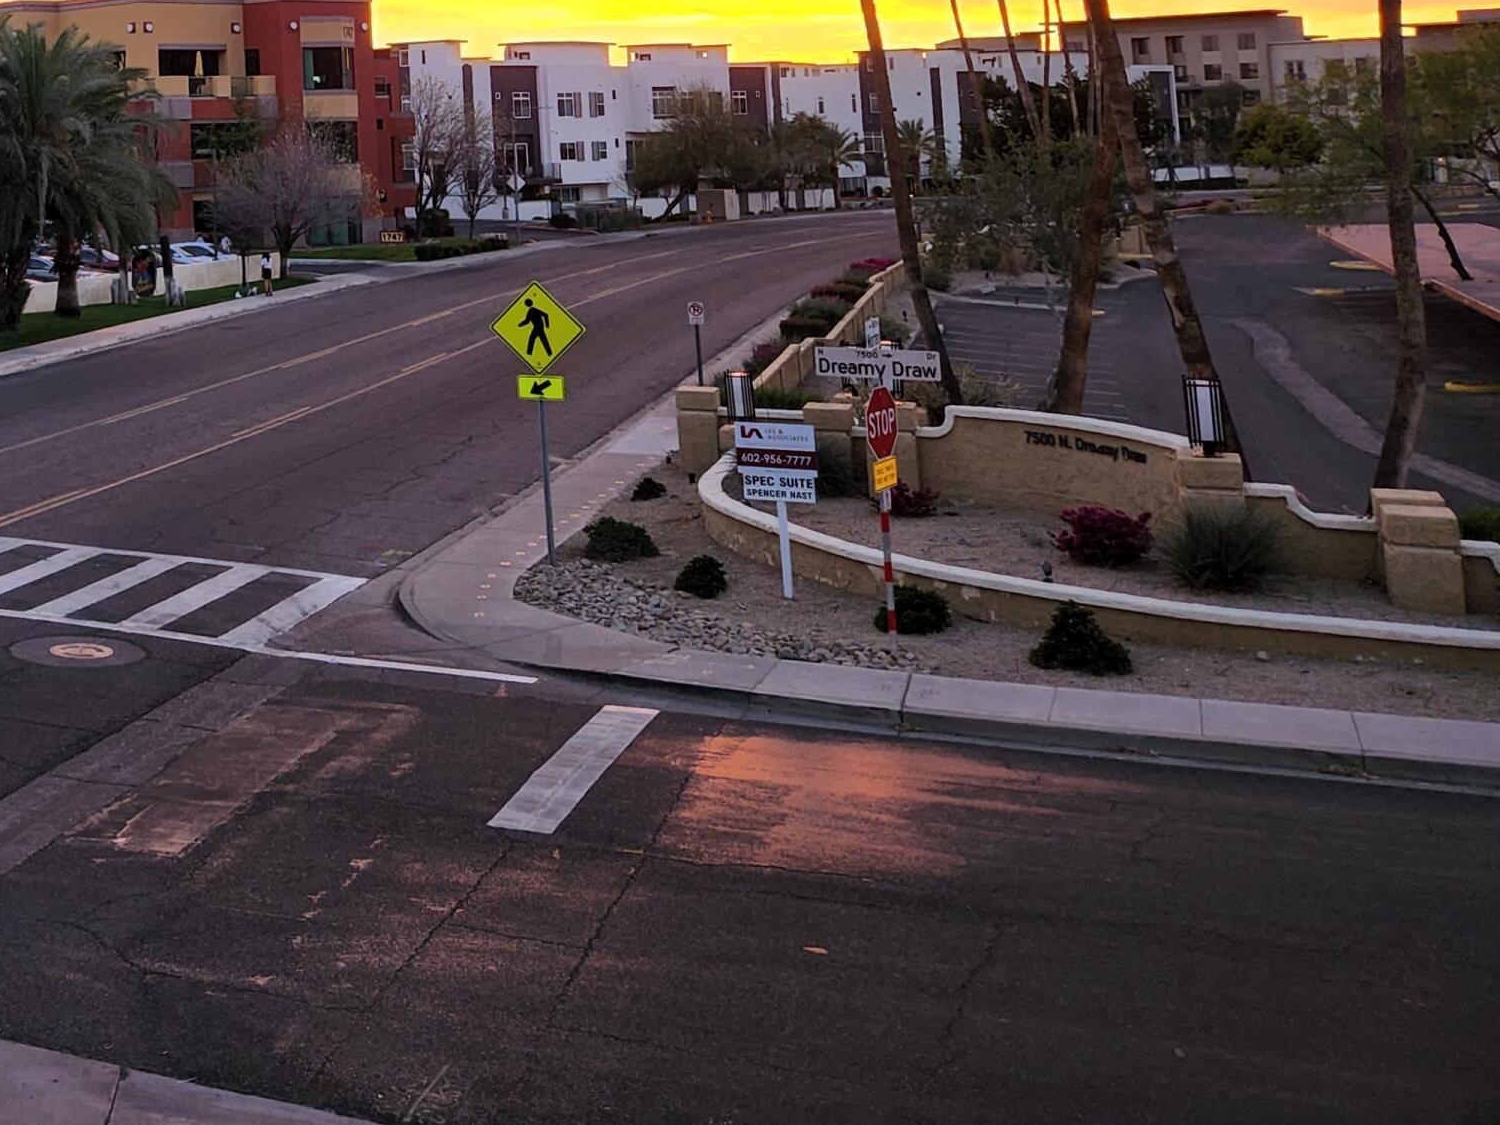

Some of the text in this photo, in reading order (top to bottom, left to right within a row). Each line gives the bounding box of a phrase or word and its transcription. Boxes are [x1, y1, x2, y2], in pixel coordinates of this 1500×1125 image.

[382, 233, 402, 241] 1747
[855, 351, 878, 359] 7500
[818, 358, 937, 379] Dreamy Draw
[868, 408, 895, 439] STOP
[1024, 430, 1055, 447] 7500
[741, 453, 812, 466] 602-956-7777
[744, 475, 814, 489] SPEC SUITE
[746, 489, 813, 500] SPENCER NAST
